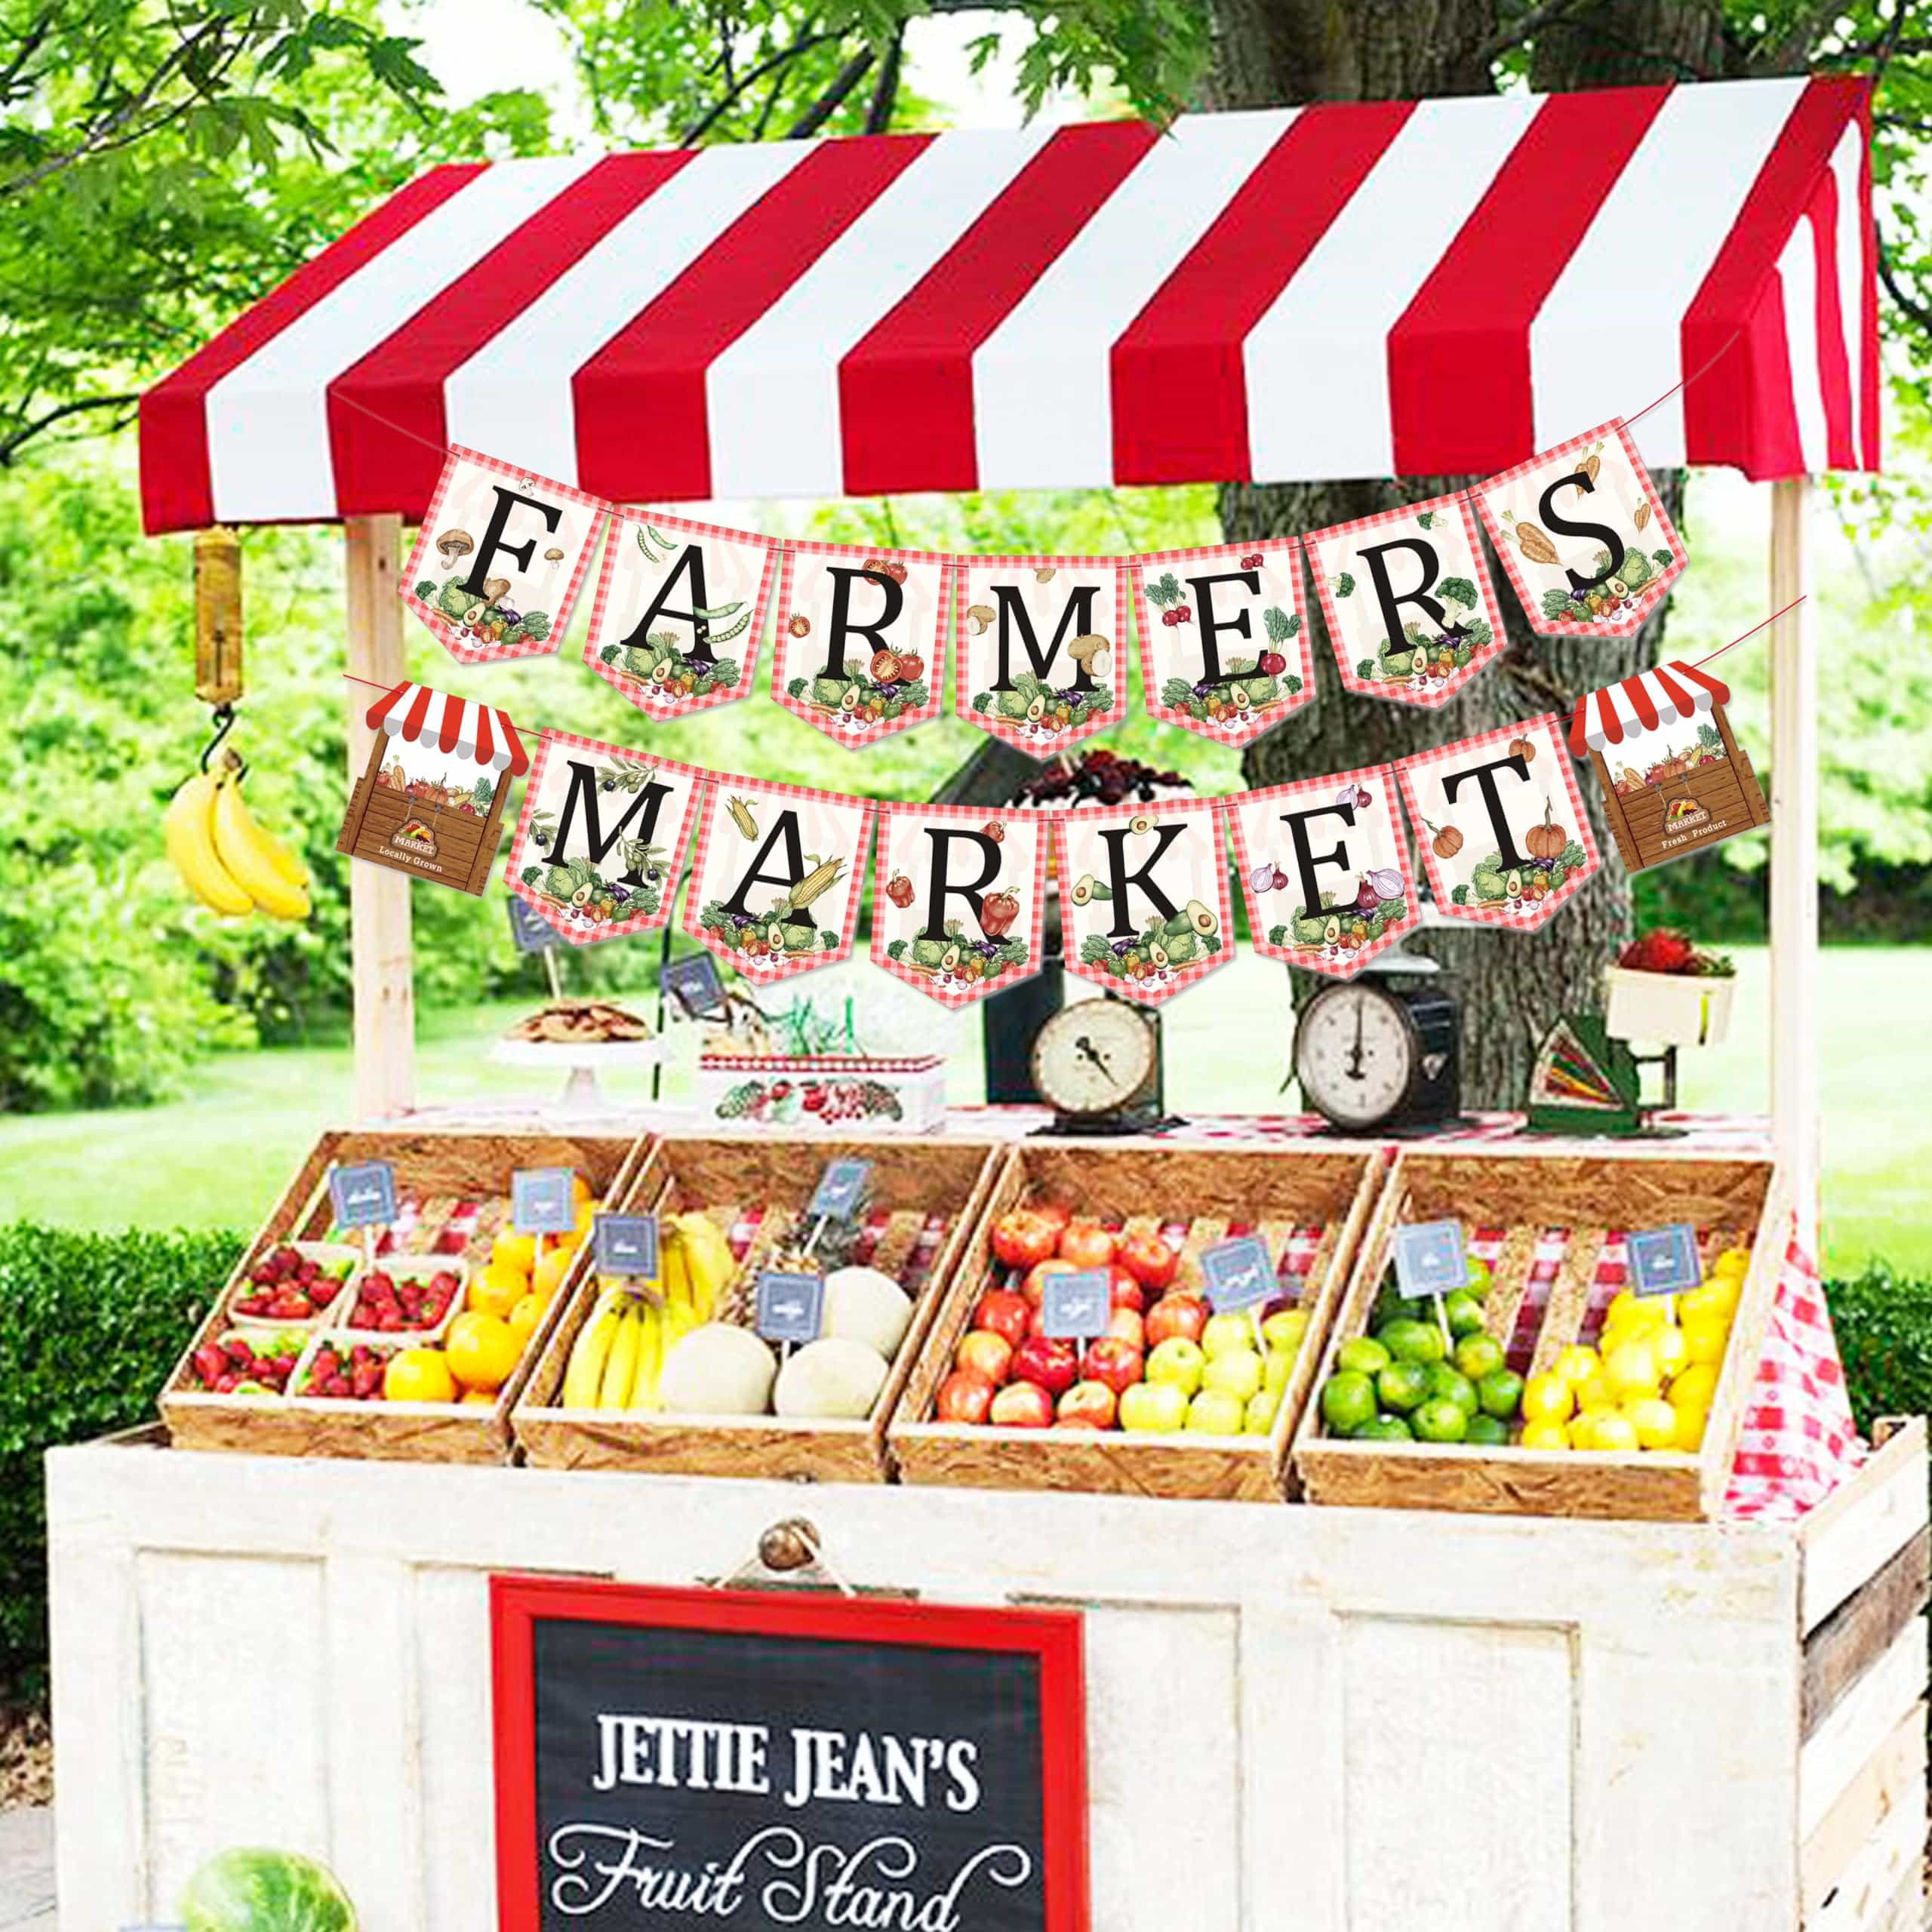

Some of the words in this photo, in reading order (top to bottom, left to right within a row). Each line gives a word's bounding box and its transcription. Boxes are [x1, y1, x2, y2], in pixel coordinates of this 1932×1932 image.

[456, 470, 1625, 692] FARMERS
[395, 835, 435, 854] MARKET
[541, 754, 1533, 945] MARKET
[1661, 834, 1687, 849] Fresh
[1692, 820, 1727, 838] Product
[1668, 811, 1706, 832] MARKET
[379, 846, 411, 863] Locally
[414, 857, 442, 872] Grown
[593, 1714, 769, 1794] JETTIE
[784, 1728, 979, 1811] JEAN'S
[549, 1823, 804, 1915] Fruit
[762, 1837, 1031, 1932] Stand
